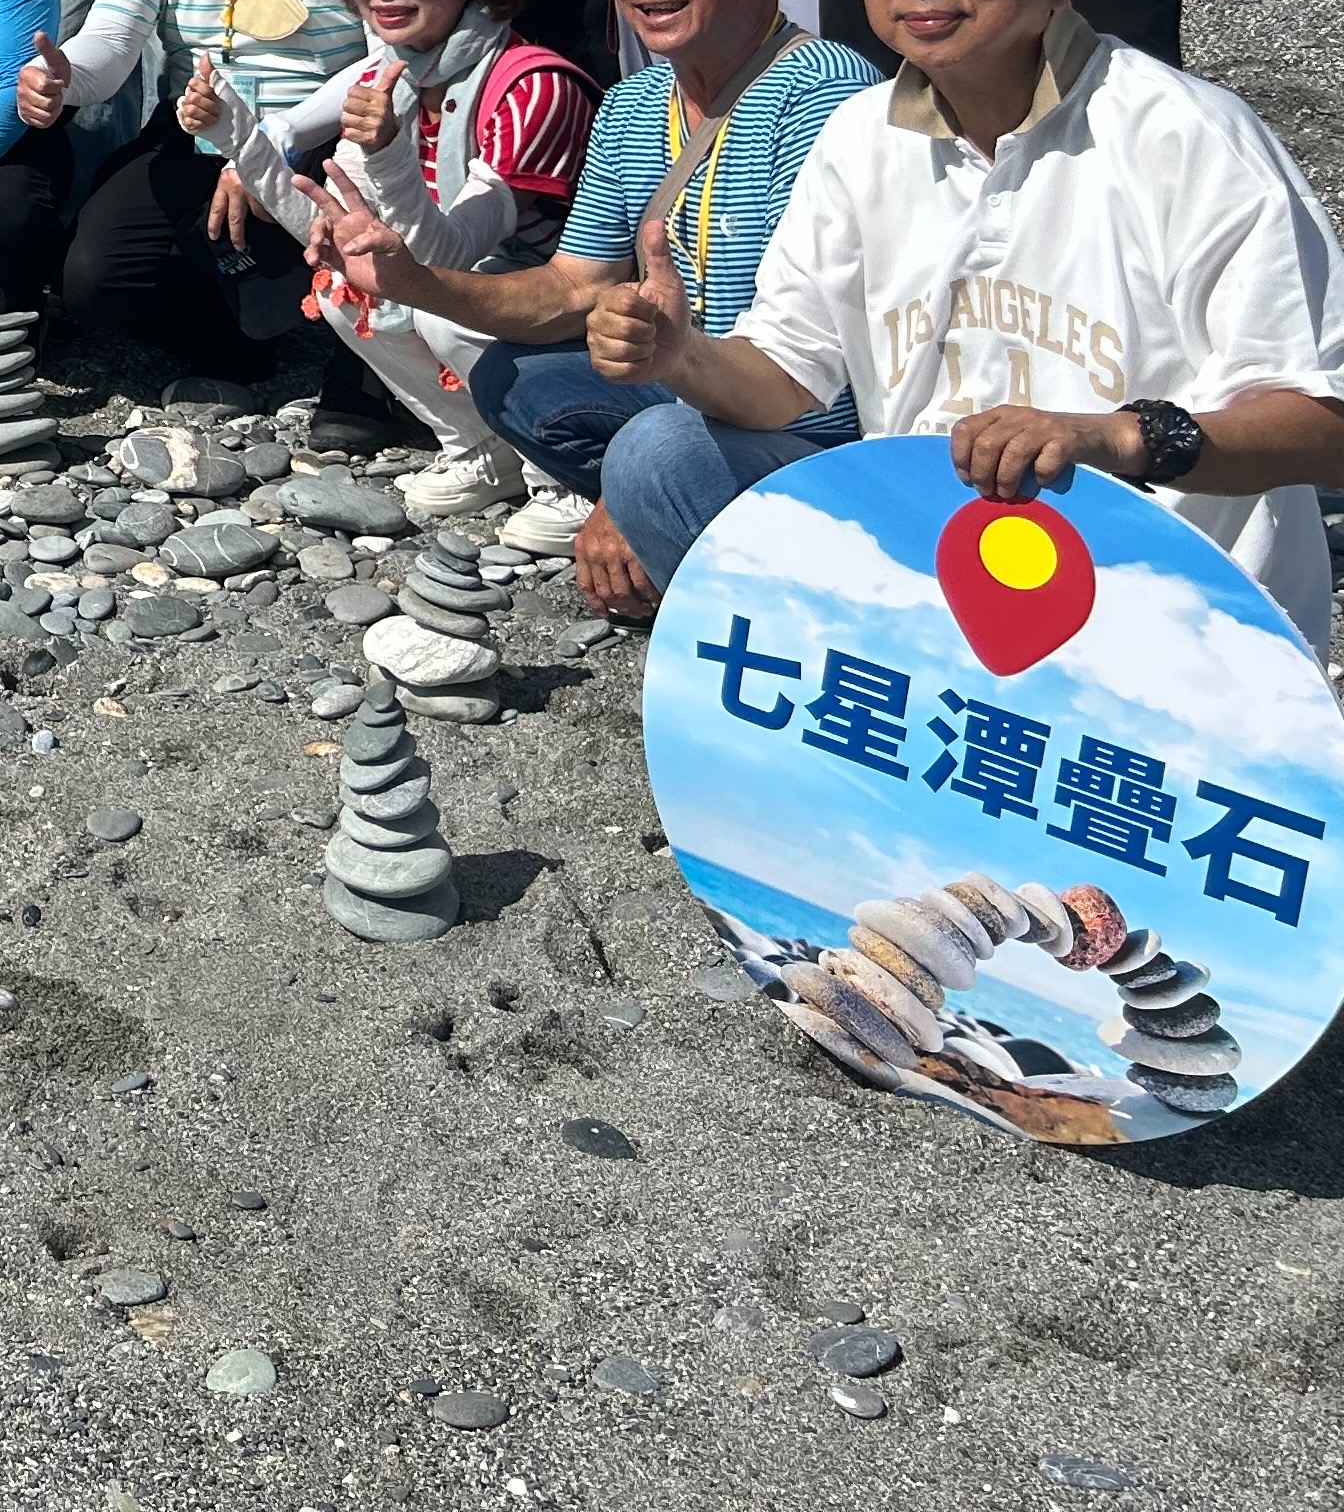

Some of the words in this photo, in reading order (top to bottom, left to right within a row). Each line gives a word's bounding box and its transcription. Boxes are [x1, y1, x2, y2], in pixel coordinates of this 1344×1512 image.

[949, 275, 1126, 405] ANGELES
[696, 614, 1326, 928] 七星潭疊石
